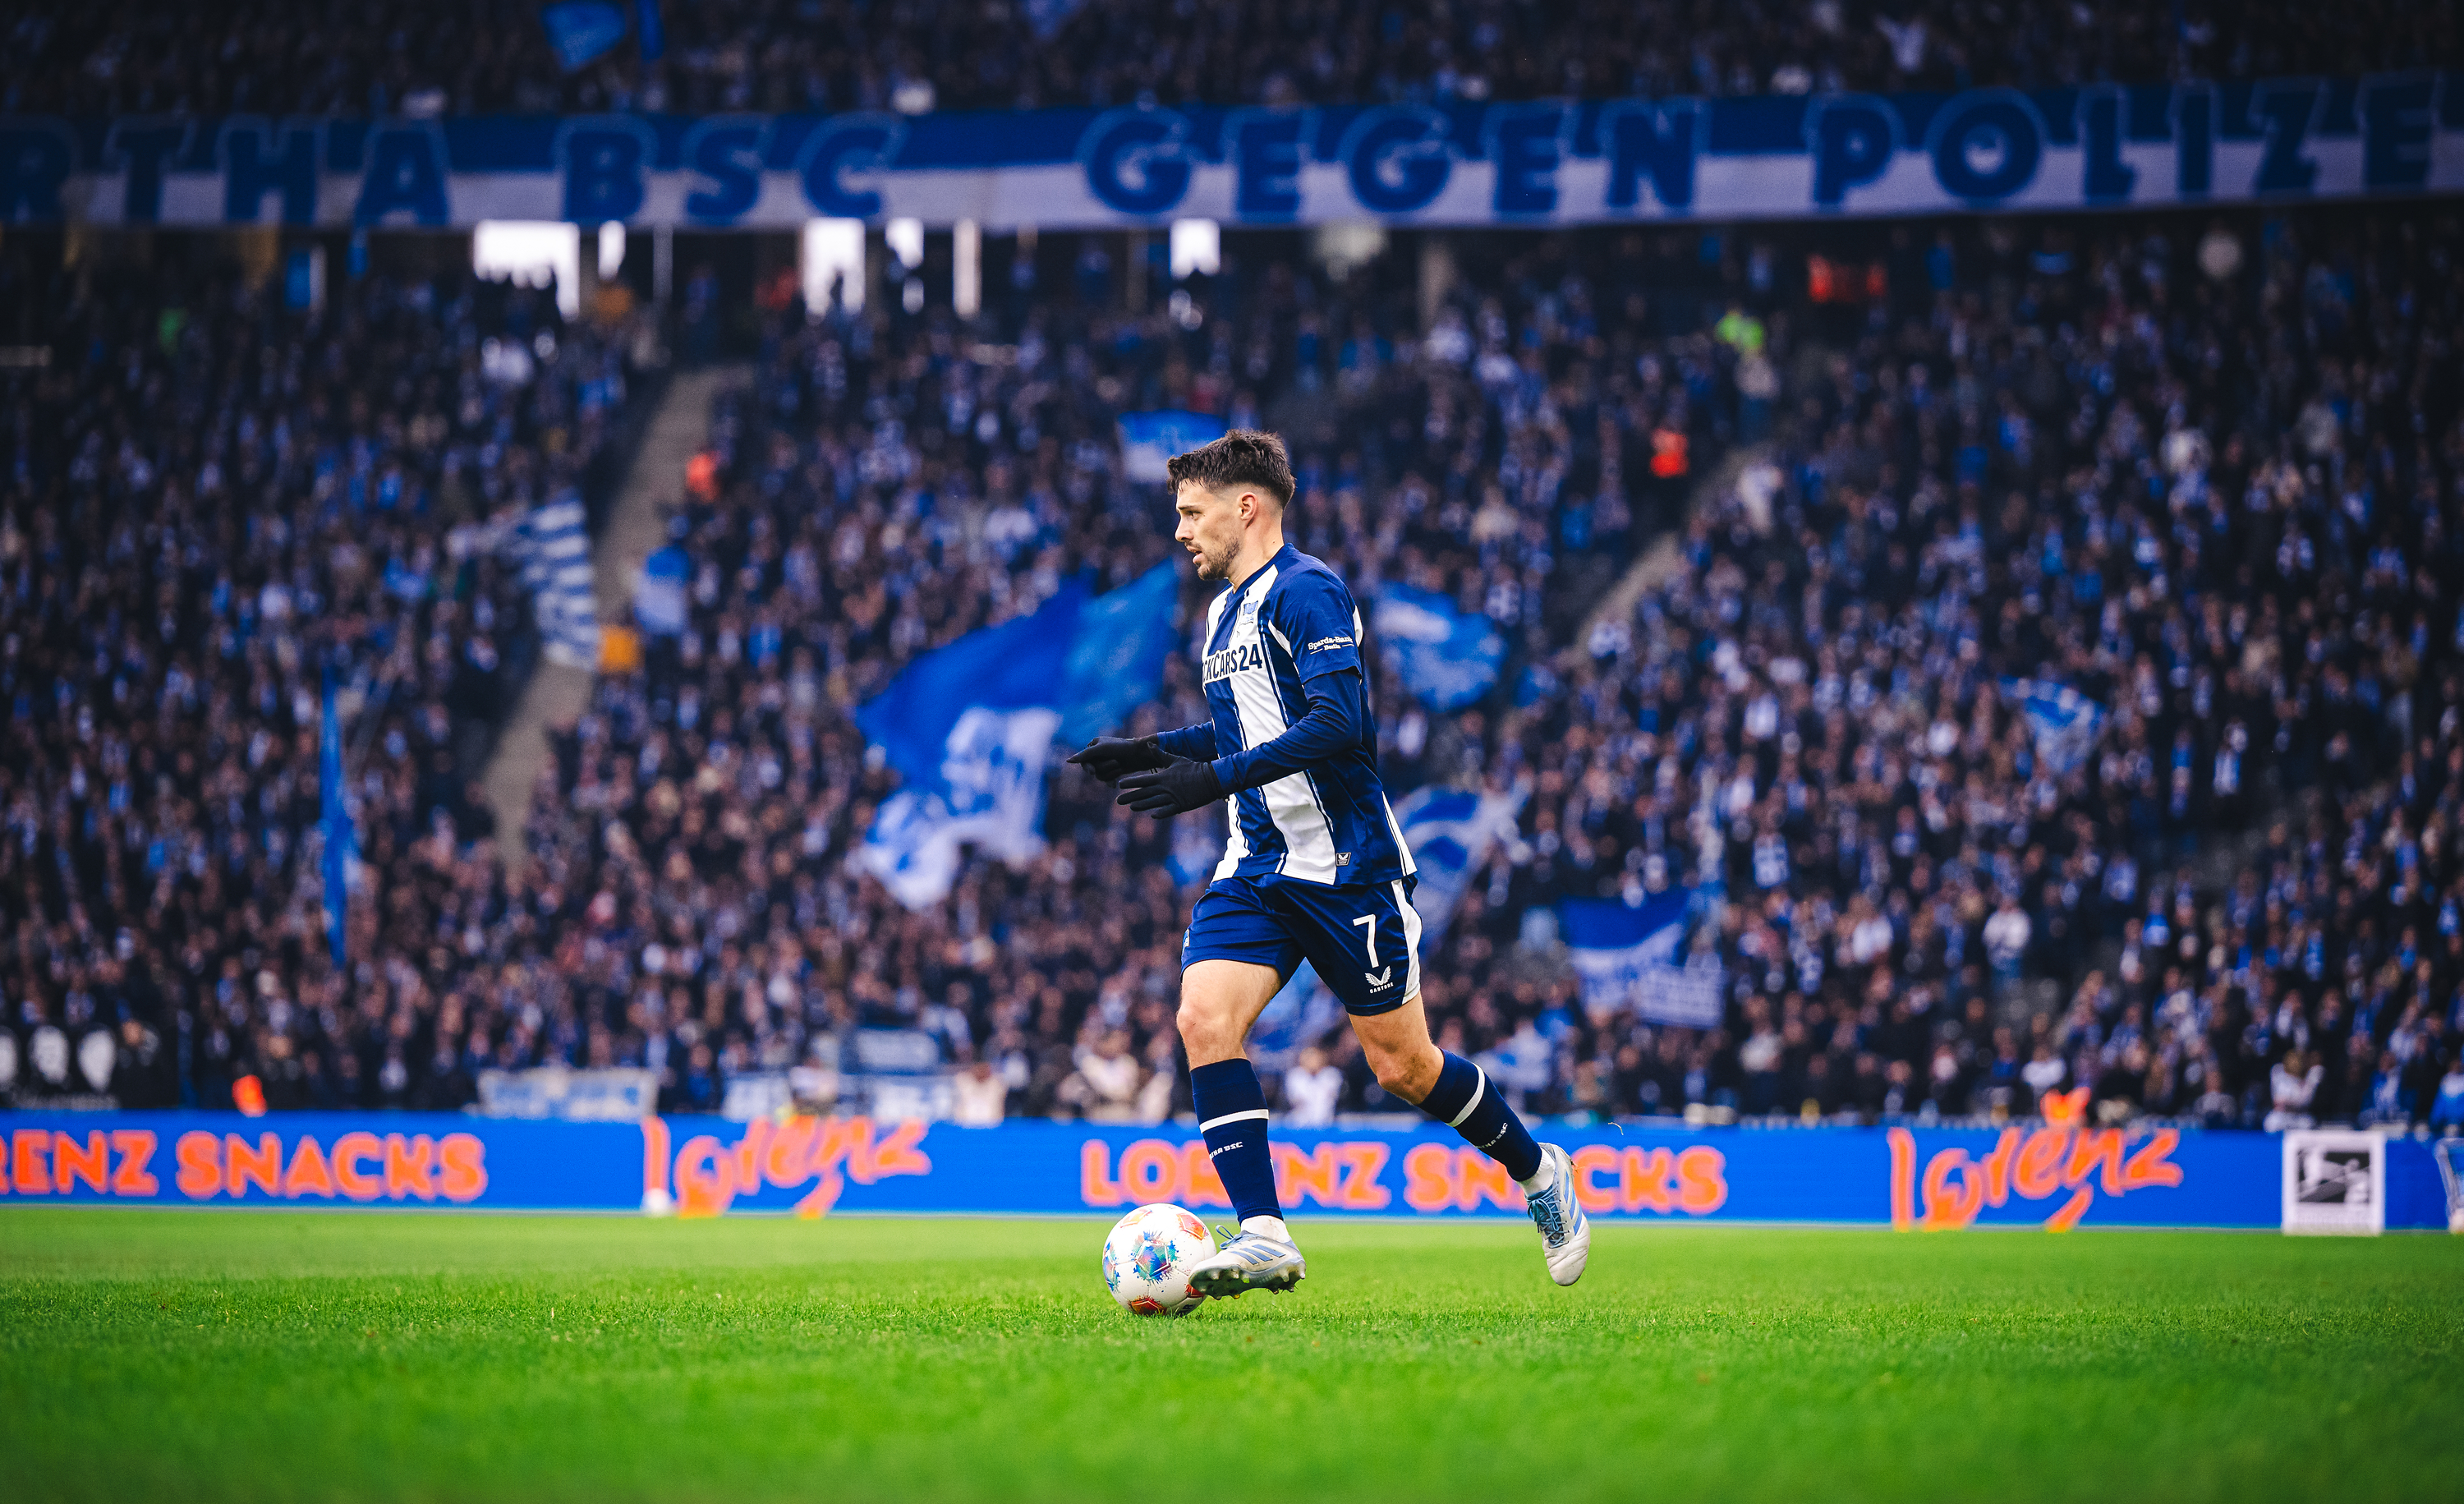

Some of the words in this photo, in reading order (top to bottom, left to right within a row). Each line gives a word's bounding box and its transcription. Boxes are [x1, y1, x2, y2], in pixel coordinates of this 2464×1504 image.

[556, 116, 900, 223] BSC
[1078, 99, 1705, 222] GEGEN
[1353, 913, 1380, 968] 7
[0, 1129, 159, 1197] ENZ
[176, 1130, 487, 1201] SNACKS
[1081, 1138, 1391, 1210] LORNZ
[1403, 1142, 1729, 1214] SNCKS
[1224, 1141, 1243, 1152] BSC
